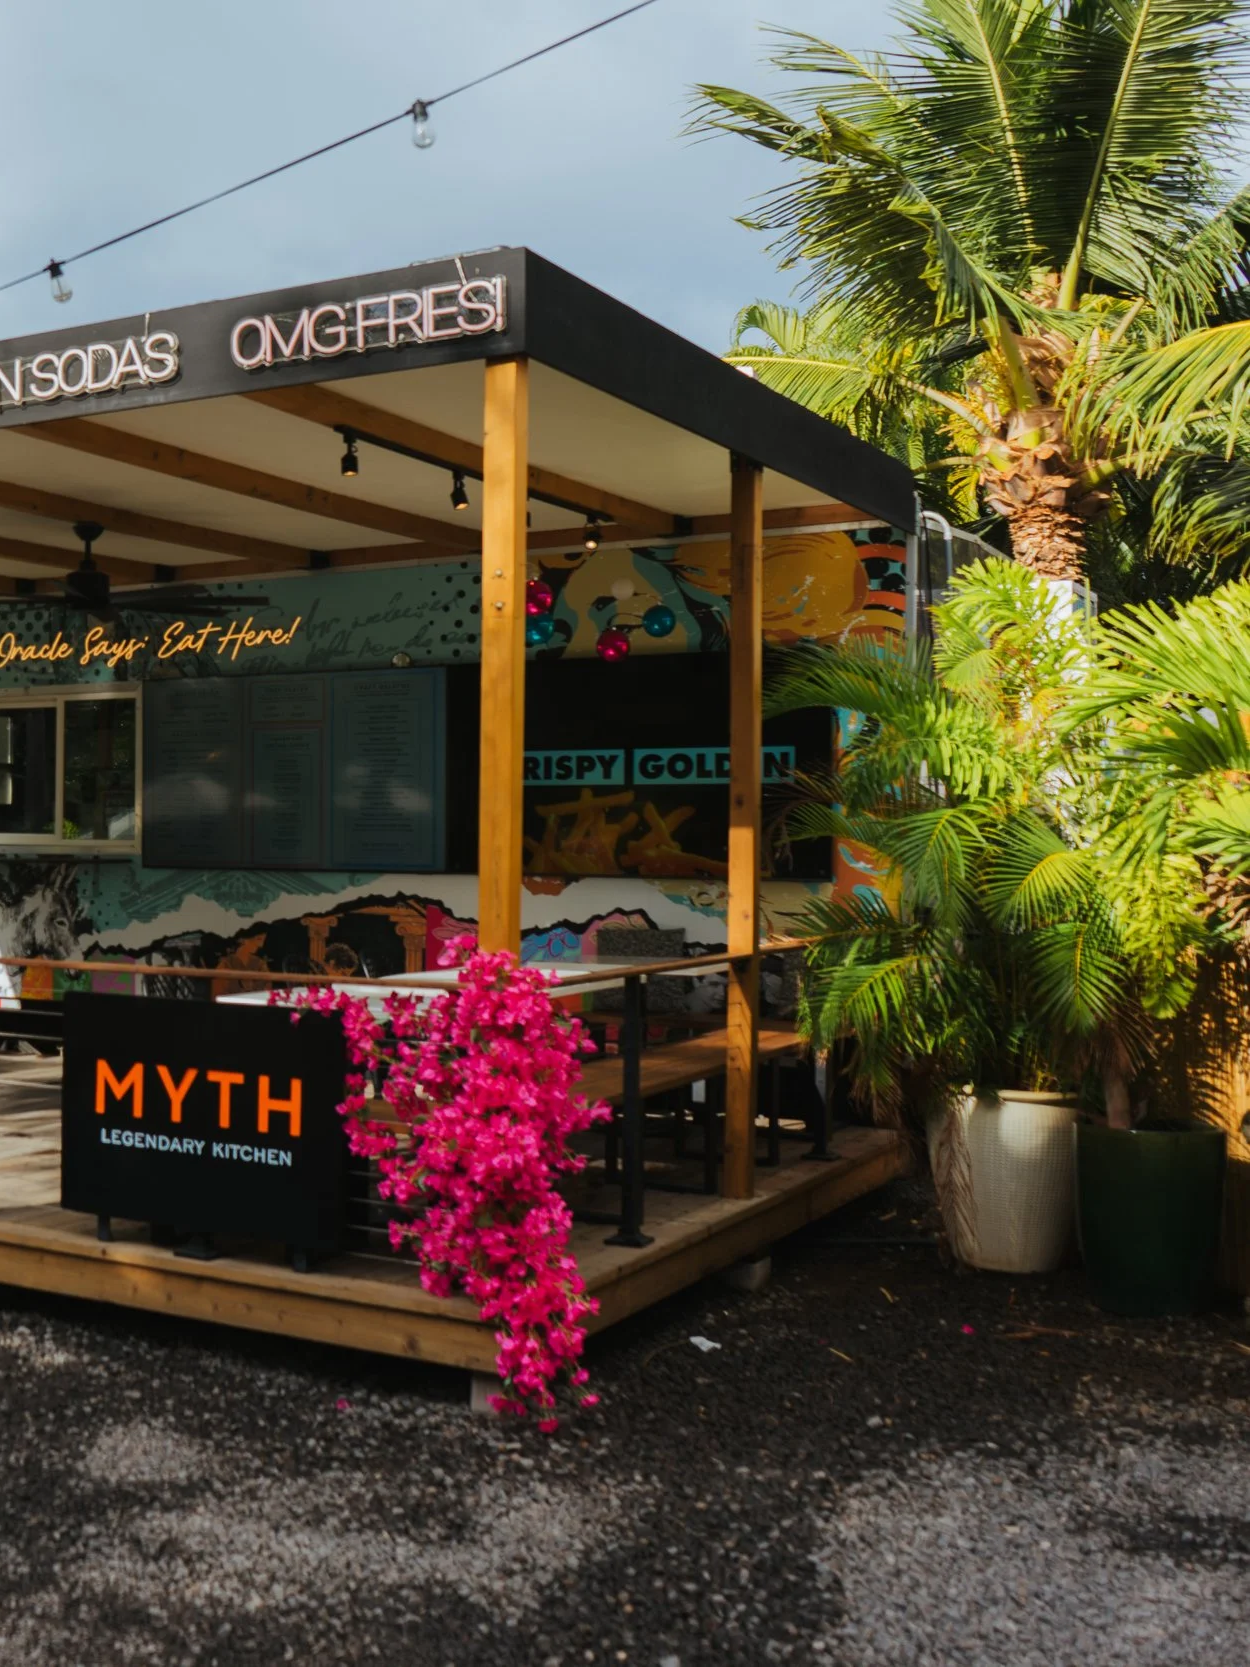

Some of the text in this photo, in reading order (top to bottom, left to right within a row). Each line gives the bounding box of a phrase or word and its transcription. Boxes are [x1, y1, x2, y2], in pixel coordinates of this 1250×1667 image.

[231, 276, 504, 369] OMG FRIES!
[29, 332, 180, 400] SODAS
[158, 621, 222, 658] Eat
[217, 616, 302, 661] Here!
[524, 751, 790, 781] RISPY GOLDN
[95, 1058, 302, 1138] MYTH
[100, 1127, 293, 1167] LEGENDARY KITCHEN
